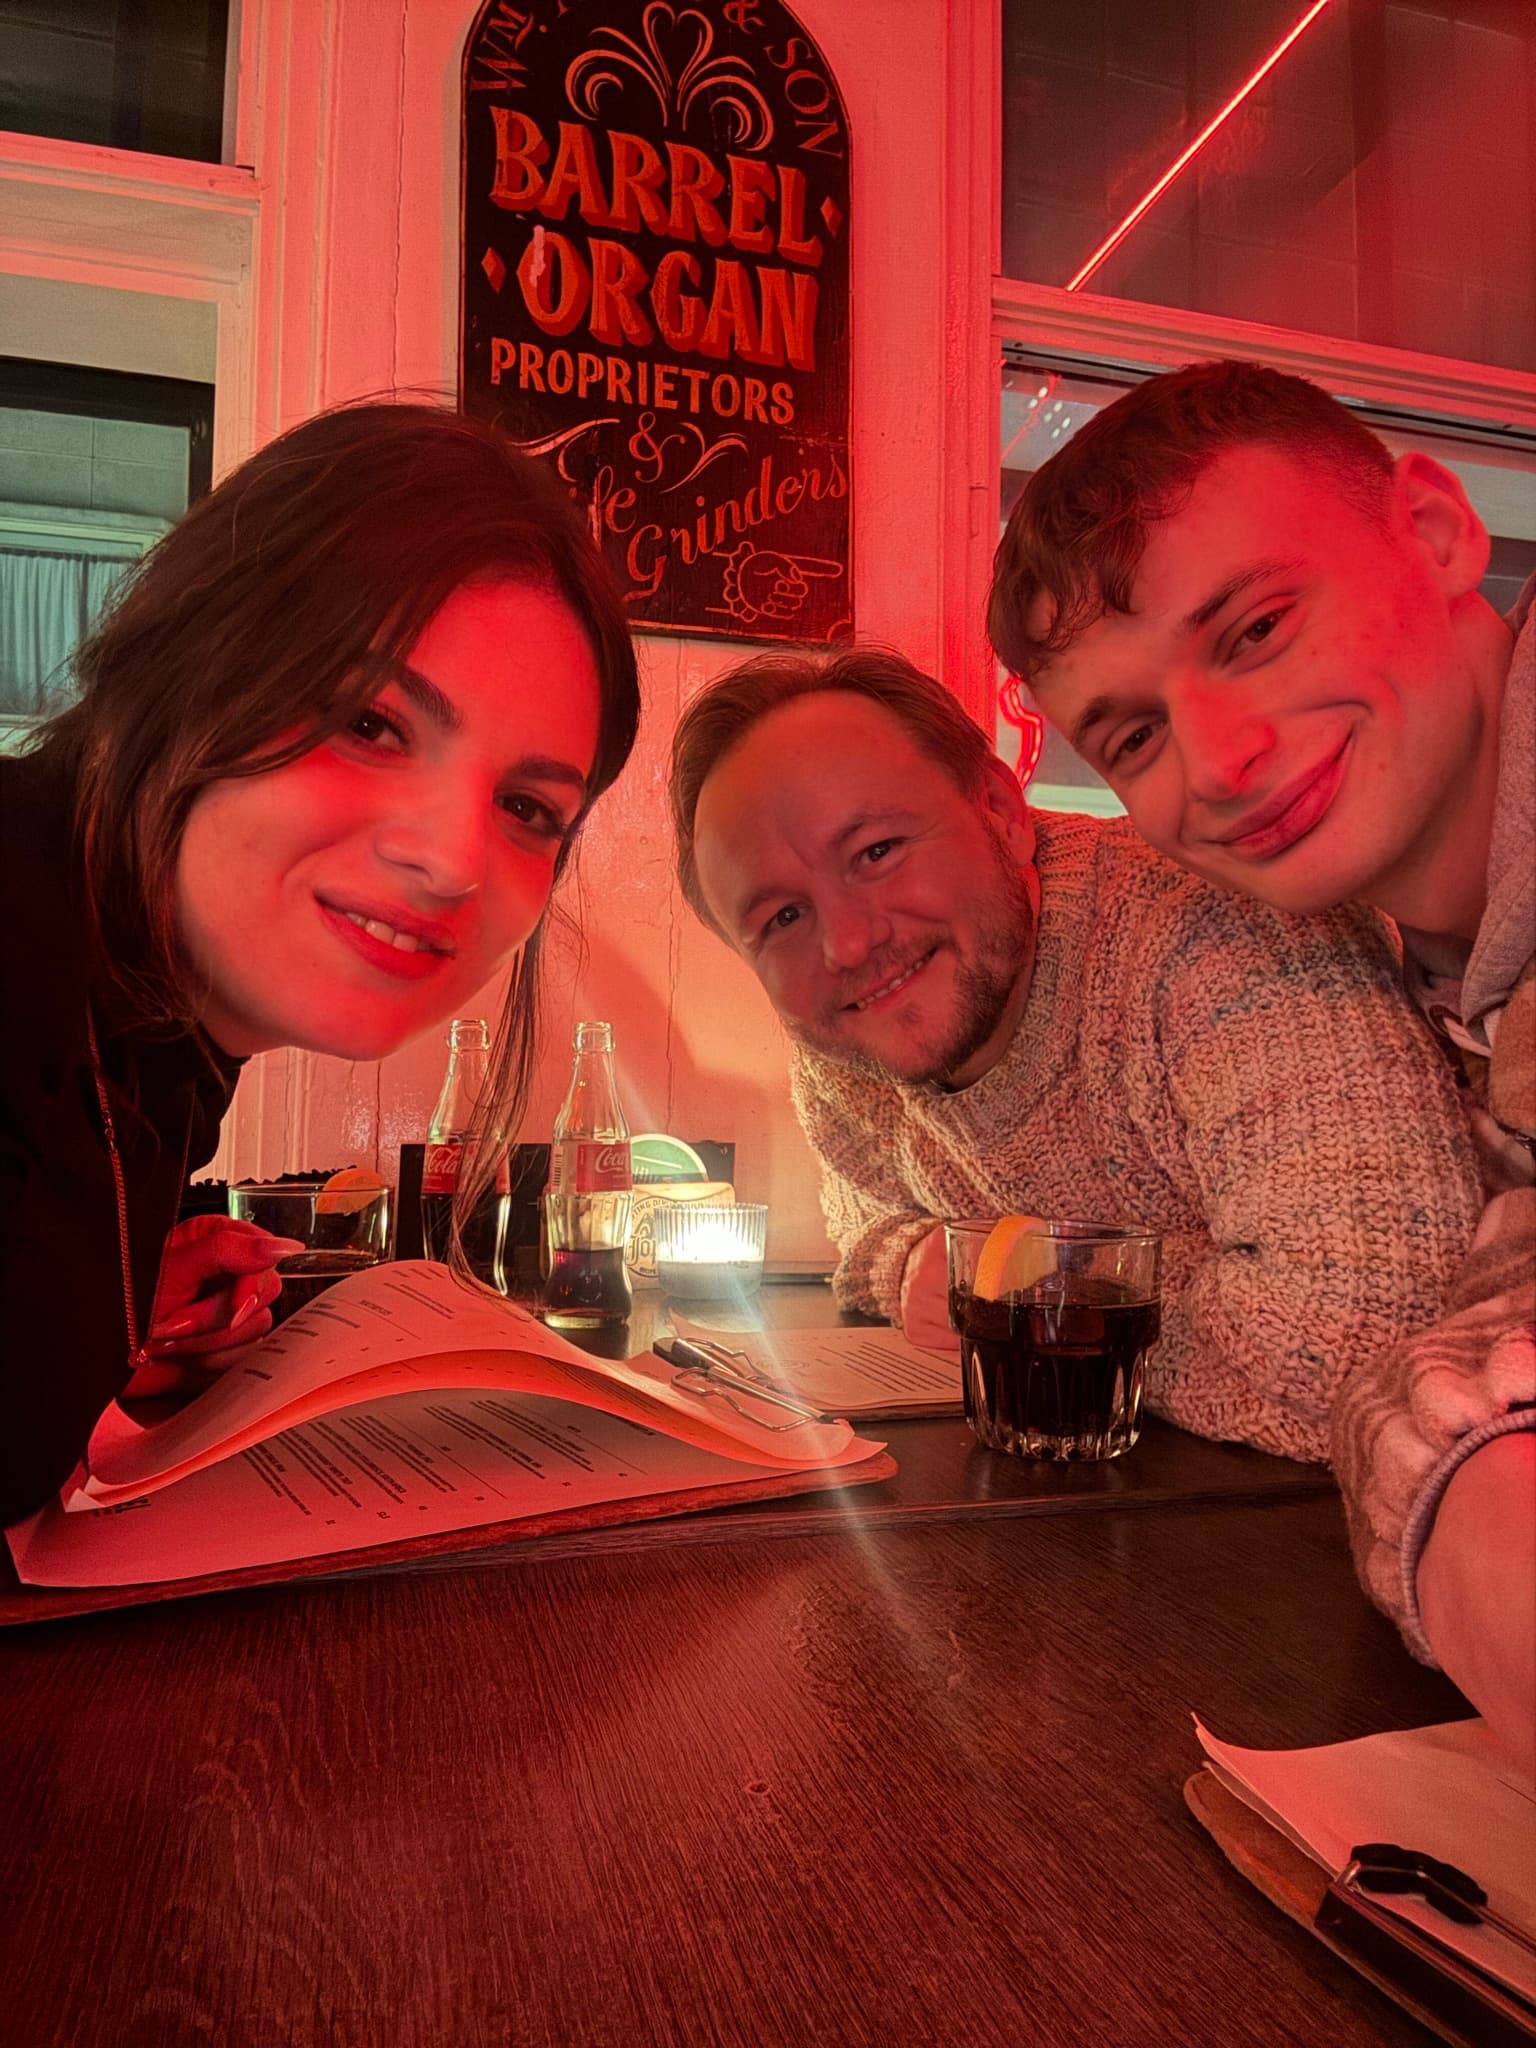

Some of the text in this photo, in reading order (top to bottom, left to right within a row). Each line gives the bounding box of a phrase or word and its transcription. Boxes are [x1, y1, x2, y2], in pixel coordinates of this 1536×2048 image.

[764, 38, 843, 159] SON
[489, 105, 823, 267] BARREL
[516, 230, 820, 373] ORGAN
[490, 337, 794, 425] PROPRIETORS
[628, 411, 687, 483] &
[623, 453, 847, 602] Grinders
